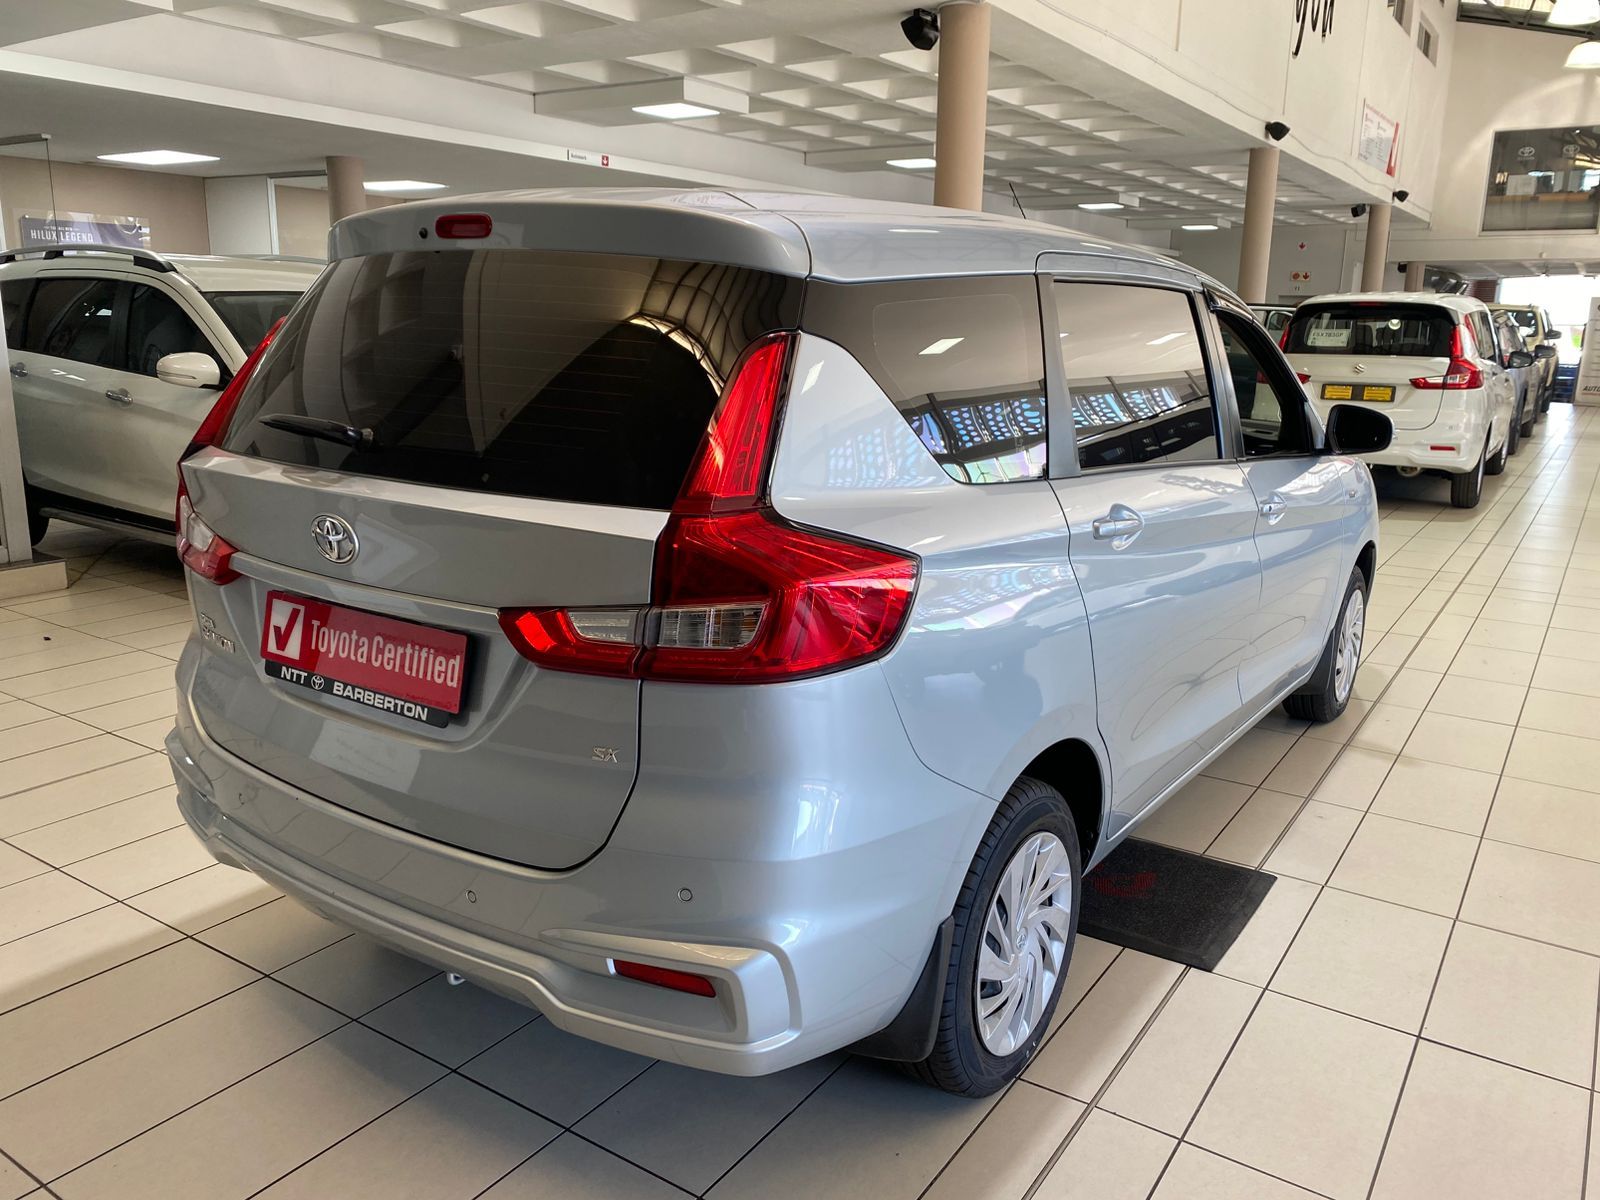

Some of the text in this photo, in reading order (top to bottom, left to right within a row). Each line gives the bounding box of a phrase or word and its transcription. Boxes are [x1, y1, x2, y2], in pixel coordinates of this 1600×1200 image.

[30, 229, 94, 243] HILUX LEGEND
[311, 620, 461, 688] Toyota Certified
[280, 665, 428, 721] NTT BARBERTON
[592, 747, 620, 764] SX
